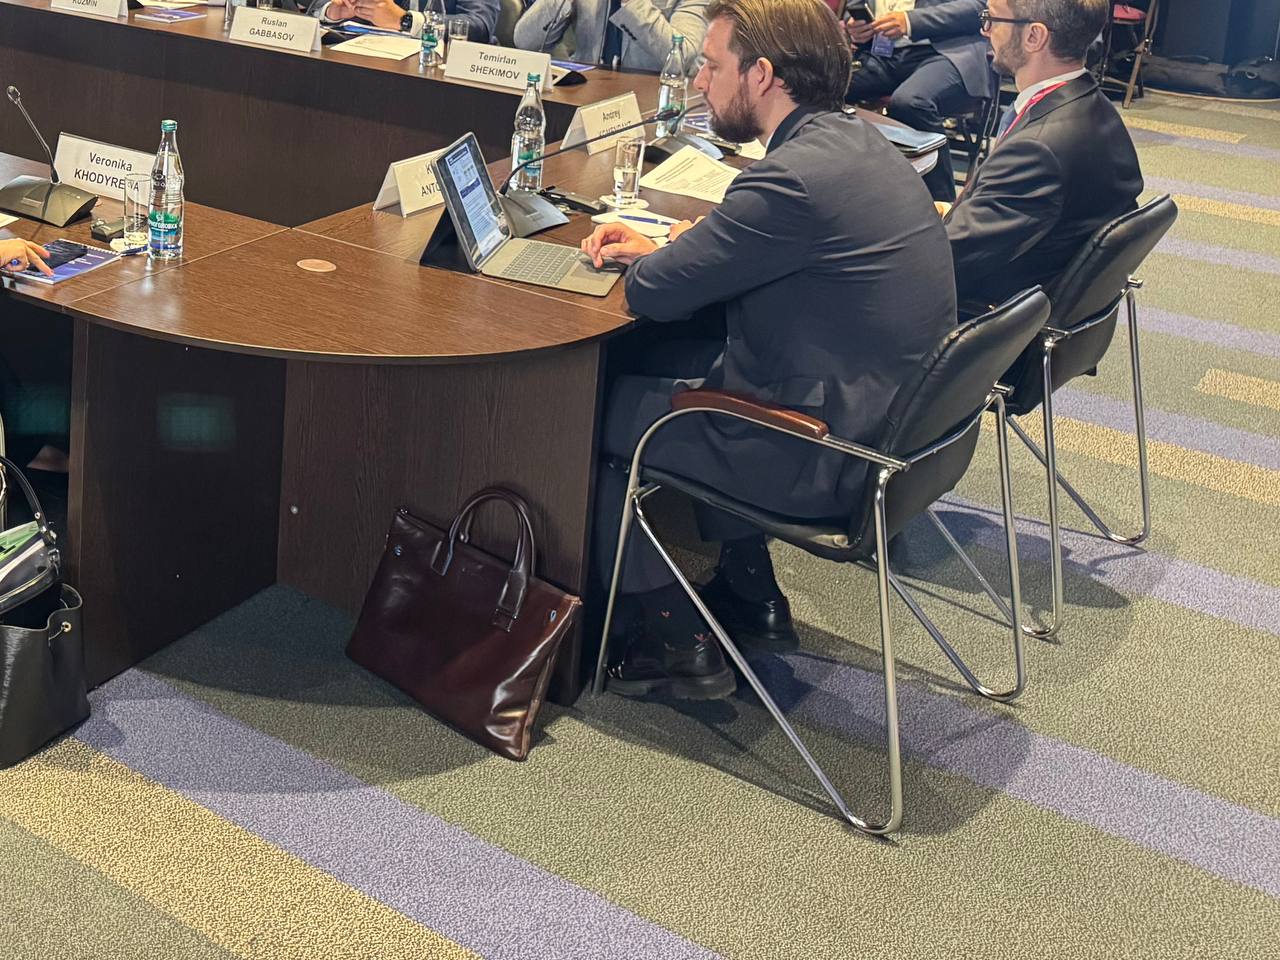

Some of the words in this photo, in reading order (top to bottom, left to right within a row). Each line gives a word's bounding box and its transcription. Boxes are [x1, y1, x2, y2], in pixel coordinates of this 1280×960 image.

[261, 16, 288, 28] Ruslan
[249, 28, 295, 41] GABBASOV
[479, 51, 517, 65] Temirlan
[469, 64, 520, 79] SHEKIMOV
[89, 152, 133, 172] Veronika
